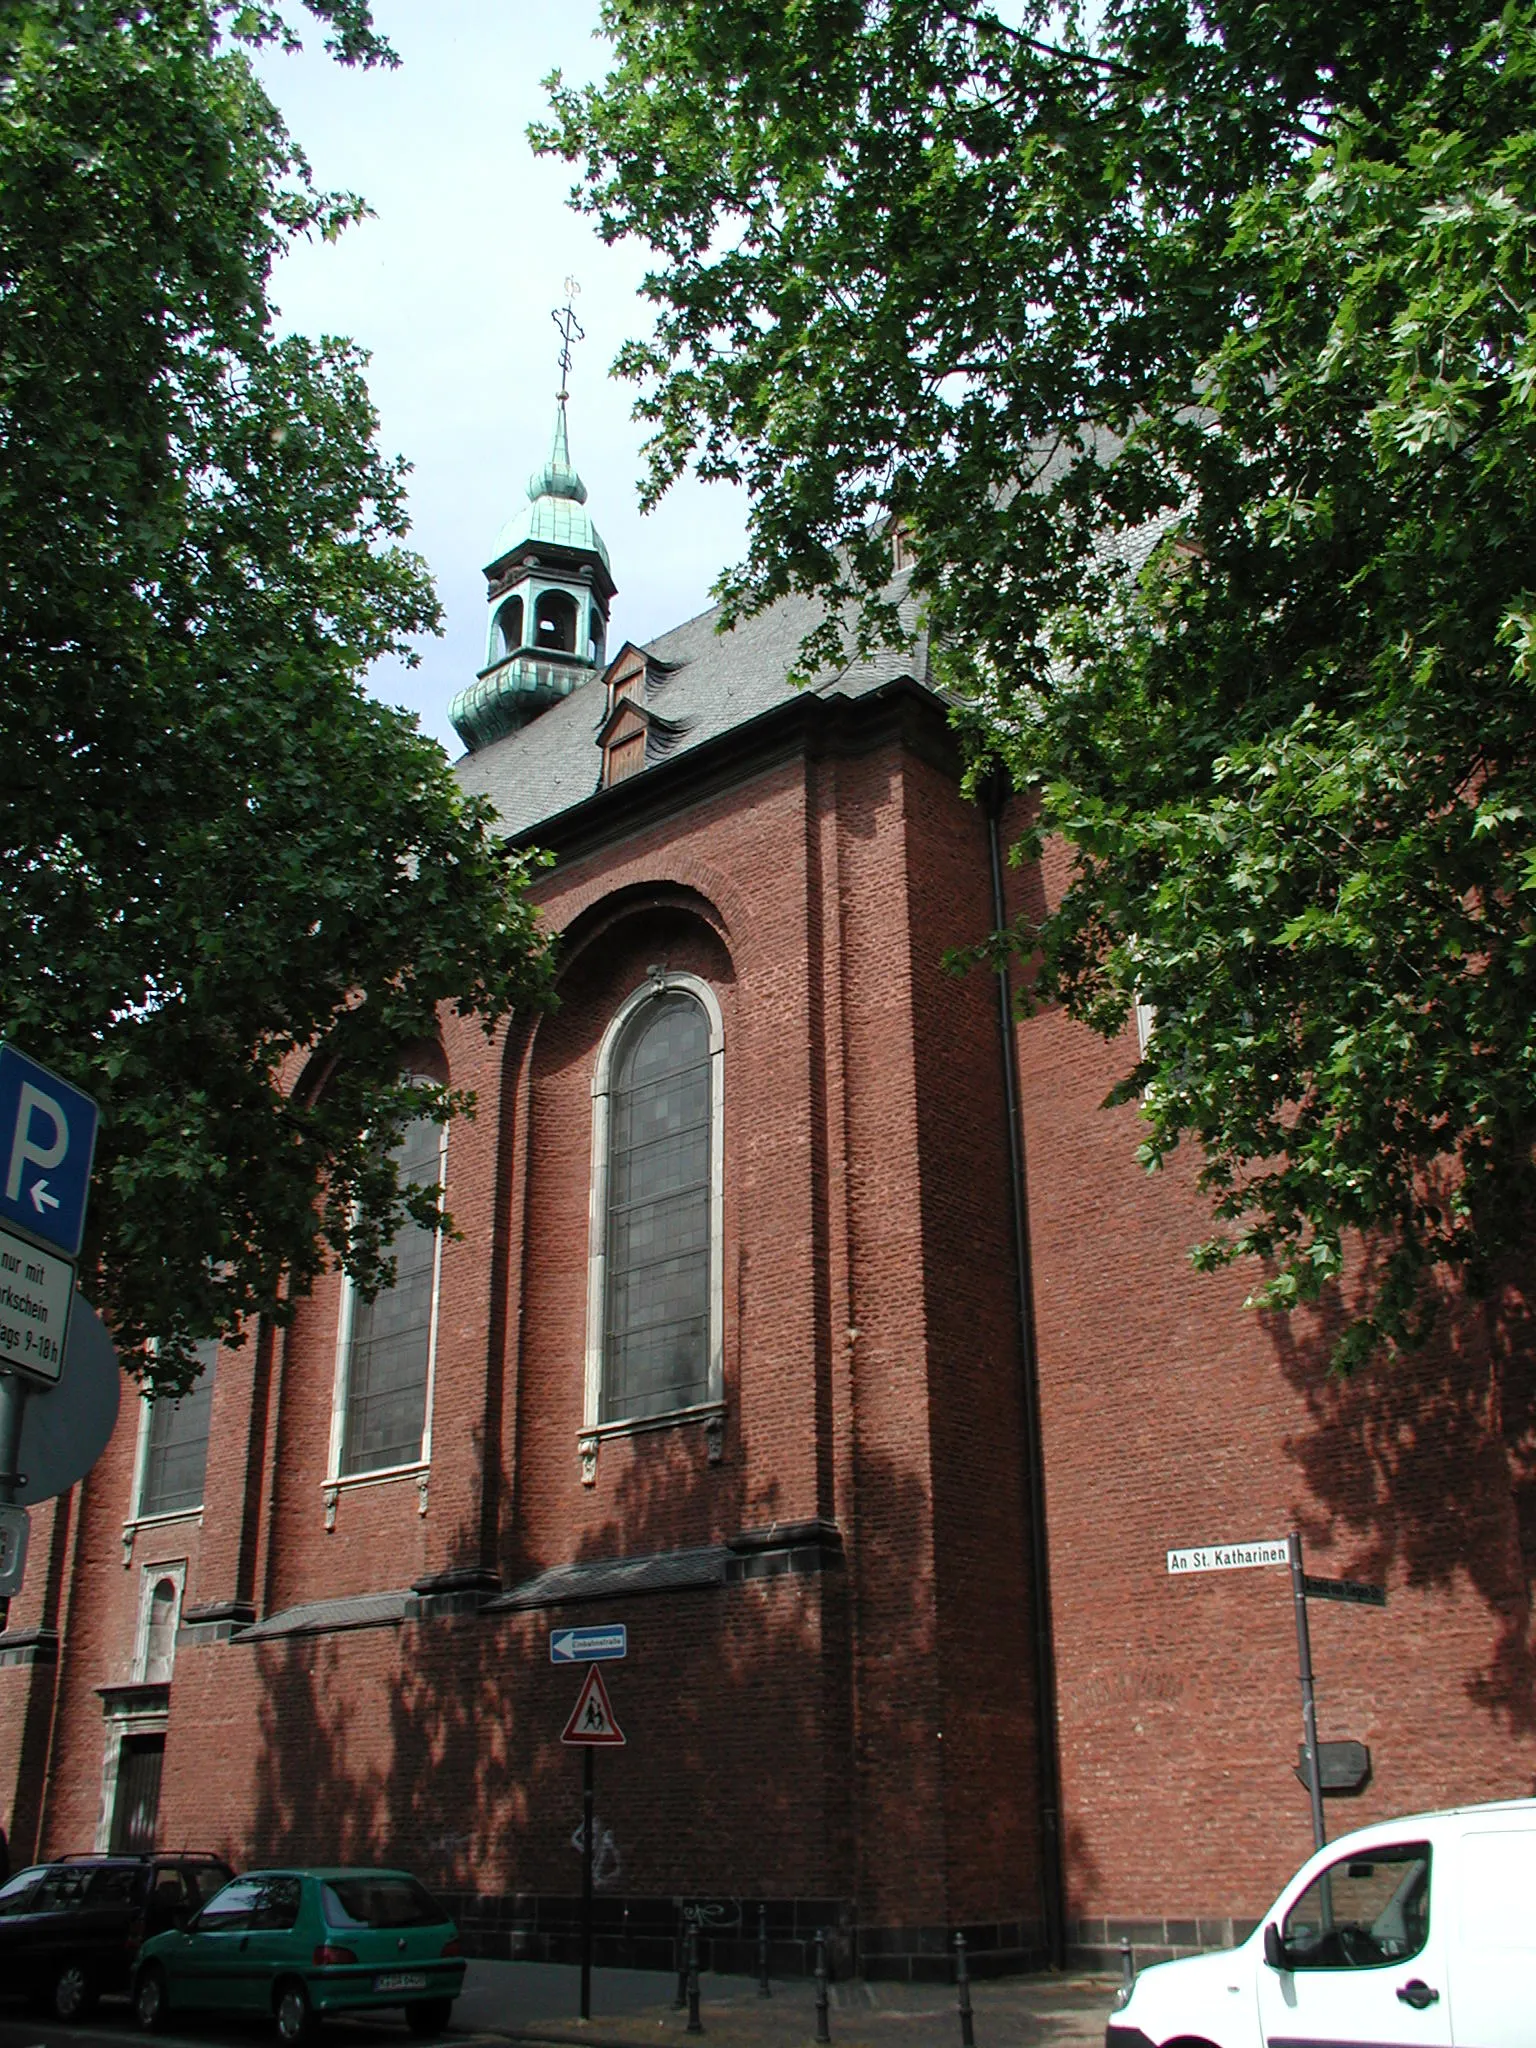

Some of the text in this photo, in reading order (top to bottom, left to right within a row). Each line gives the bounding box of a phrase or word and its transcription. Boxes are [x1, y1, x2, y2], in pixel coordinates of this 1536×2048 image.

[7, 1081, 69, 1201] P
[1, 1252, 45, 1285] nur mit
[0, 1285, 48, 1323] rkschein
[0, 1322, 20, 1350] ags
[1171, 1545, 1285, 1569] An St. Katharinen
